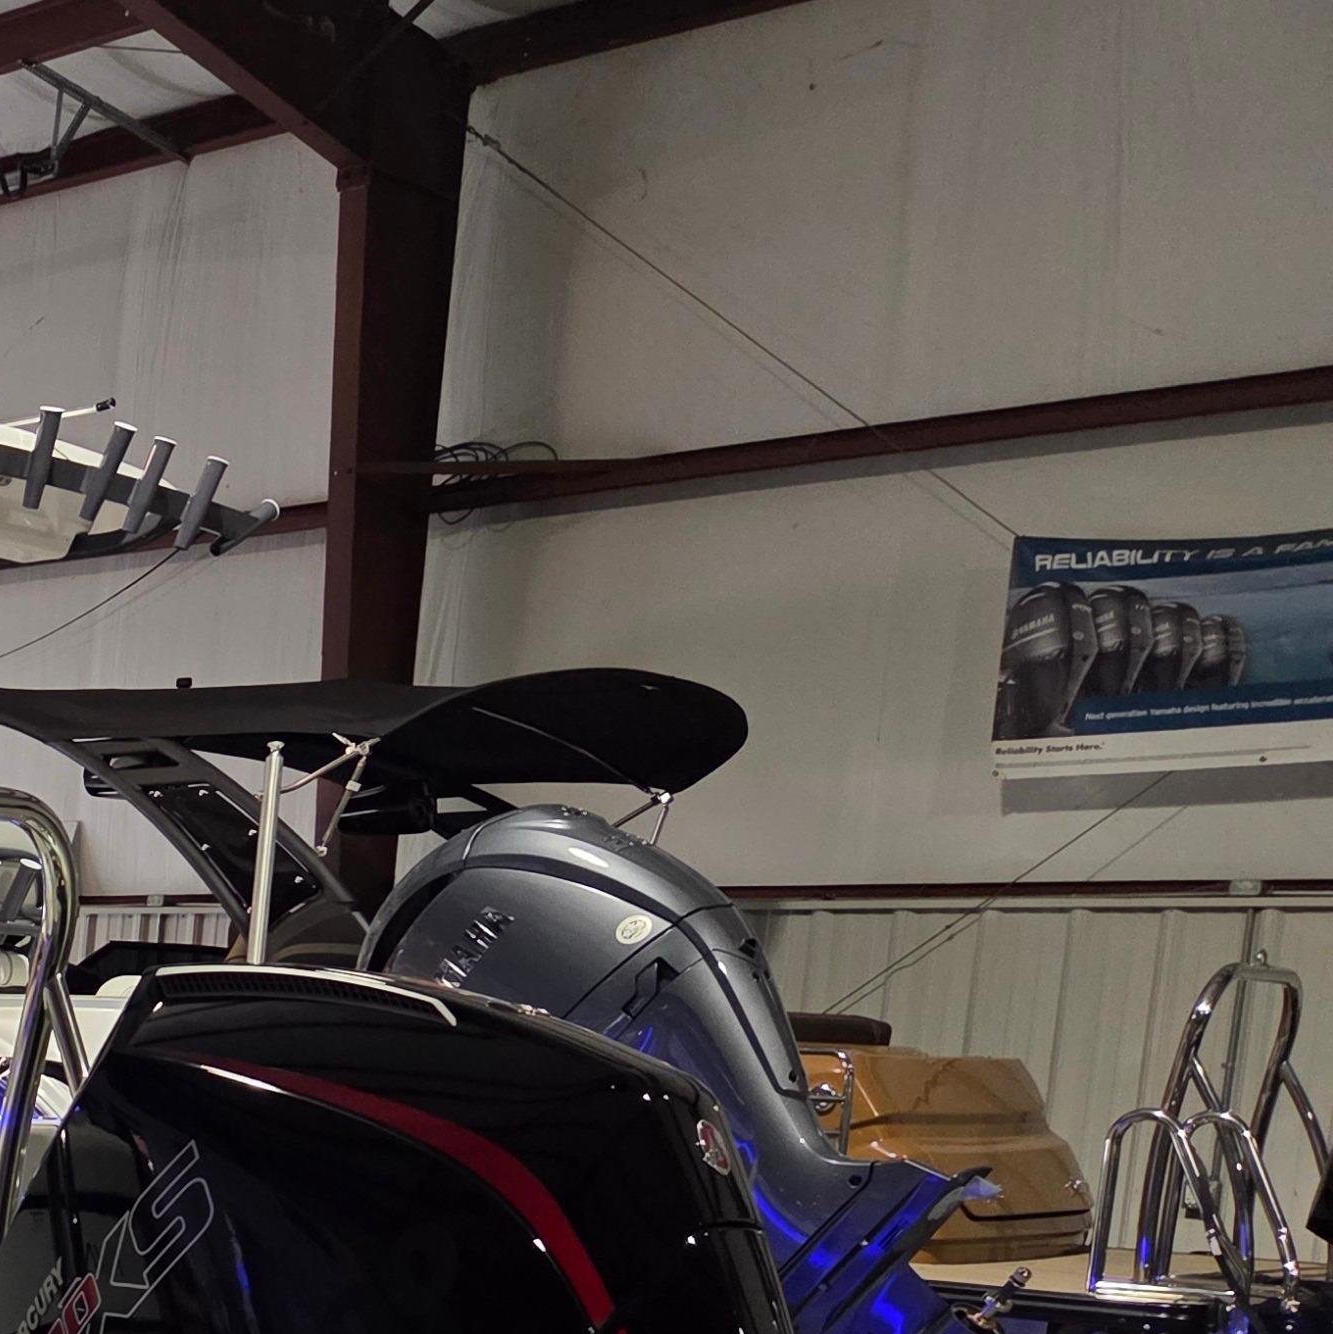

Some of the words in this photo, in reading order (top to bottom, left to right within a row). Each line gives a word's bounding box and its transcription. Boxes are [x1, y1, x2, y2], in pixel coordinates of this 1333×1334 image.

[1035, 549, 1199, 572] RELIABILITY
[1206, 548, 1236, 560] IS
[1241, 546, 1263, 557] A
[437, 905, 515, 990] MAHA
